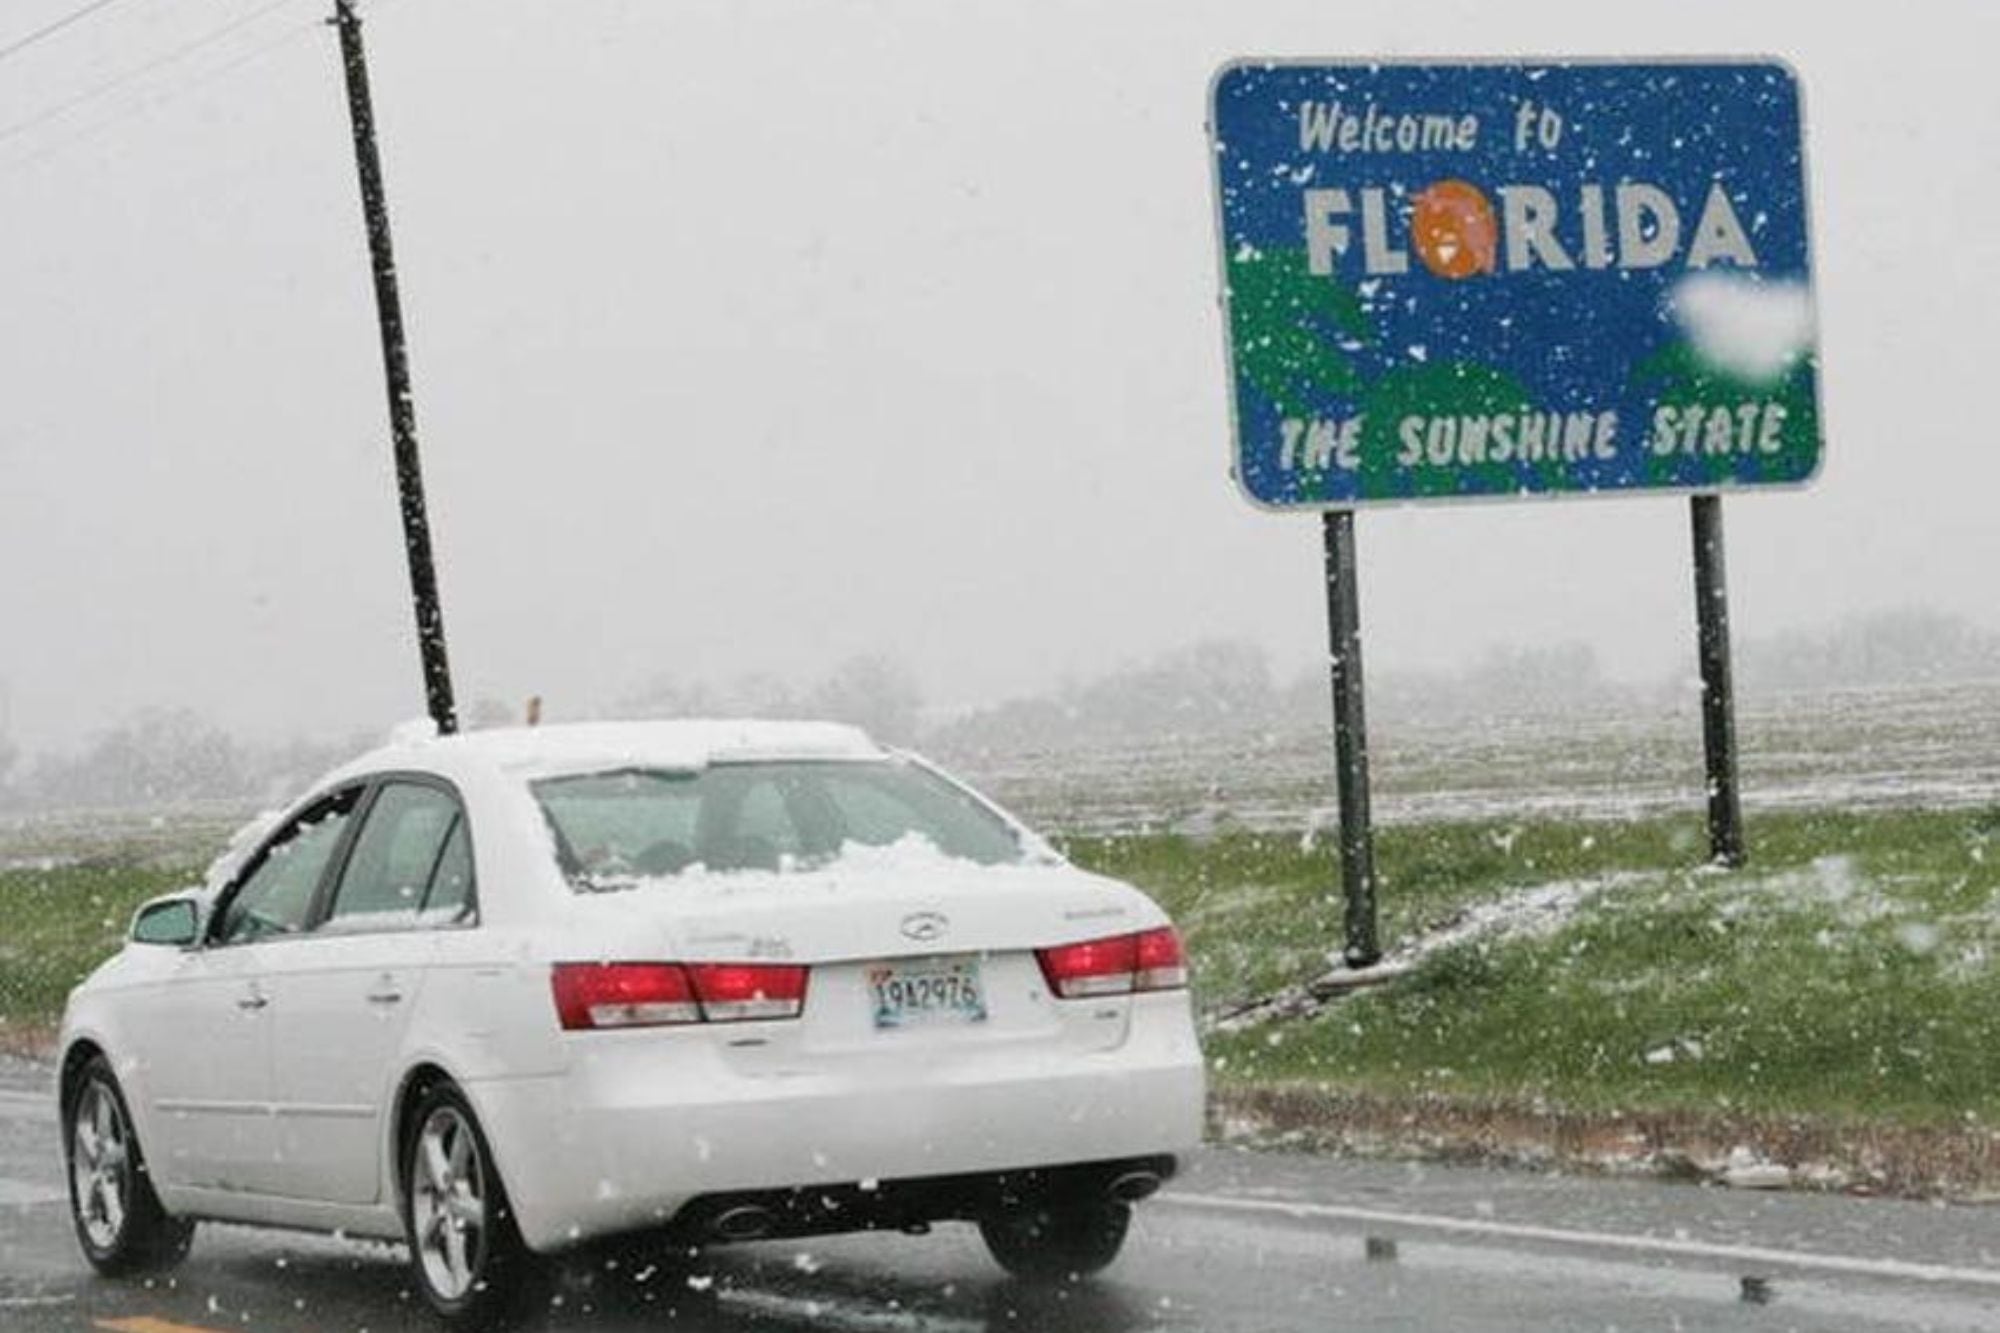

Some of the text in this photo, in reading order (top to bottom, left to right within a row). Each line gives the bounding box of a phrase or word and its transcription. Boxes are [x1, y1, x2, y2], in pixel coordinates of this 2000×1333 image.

[1299, 100, 1562, 153] Welcome to
[1304, 179, 1758, 279] FLORIDA
[1279, 403, 1788, 470] THE SUNSHINE STATE
